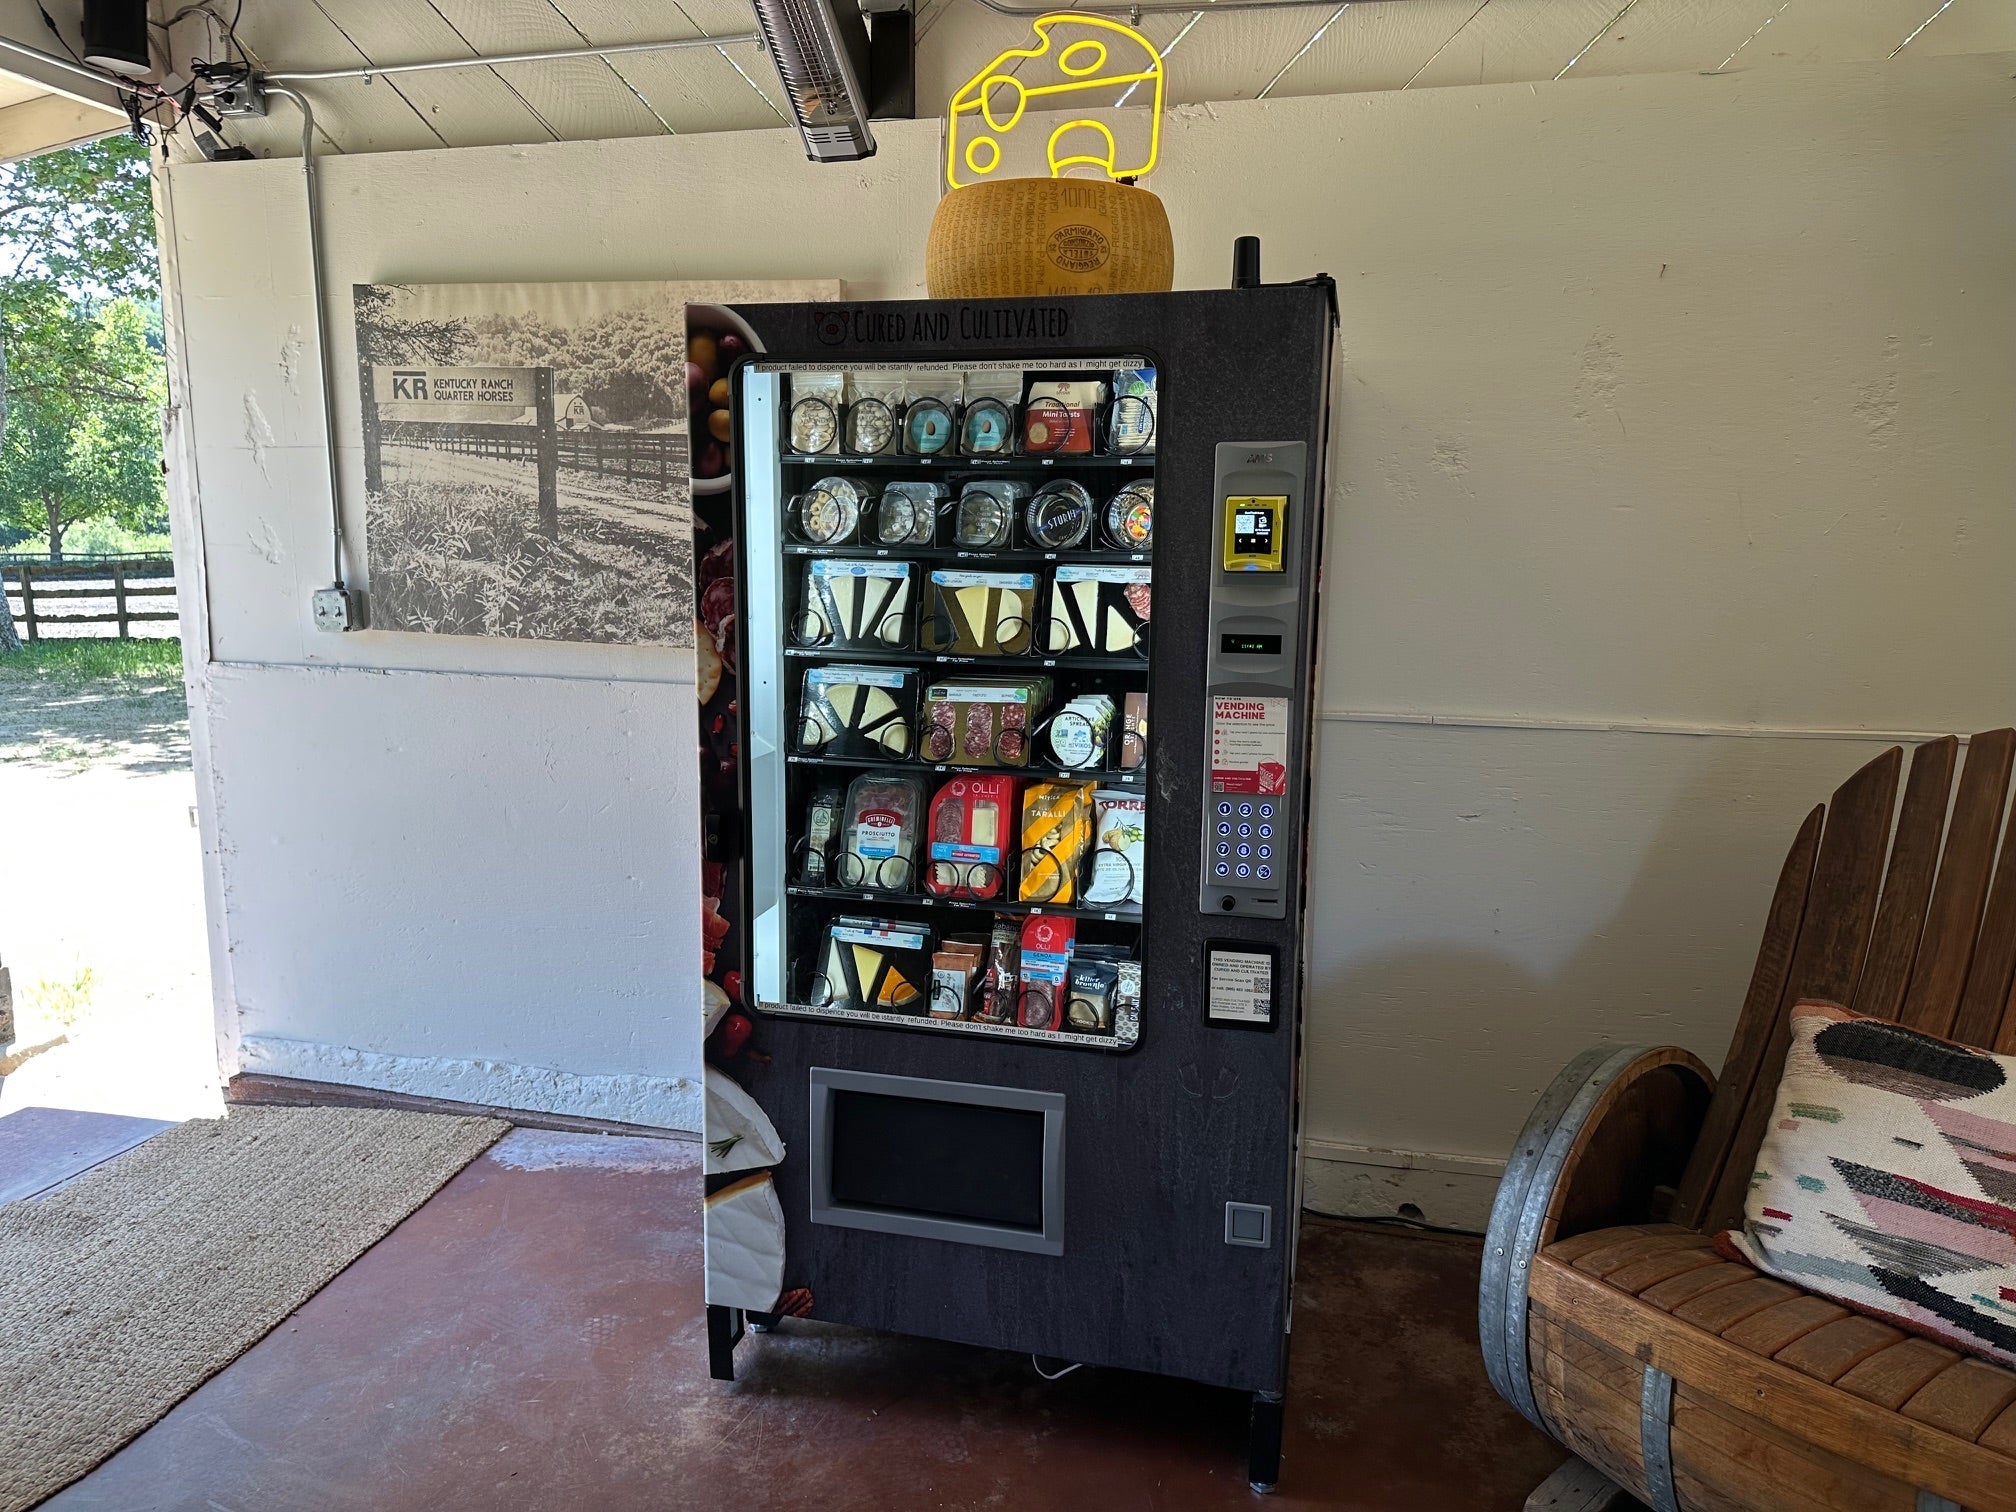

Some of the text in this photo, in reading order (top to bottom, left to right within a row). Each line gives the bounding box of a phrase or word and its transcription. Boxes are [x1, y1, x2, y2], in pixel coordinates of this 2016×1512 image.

[1054, 227, 1104, 246] PARMIGIANO
[1055, 255, 1101, 271] REGGIANO
[762, 364, 787, 372] product
[788, 363, 807, 371] failed
[808, 363, 815, 371] to
[817, 363, 848, 372] dispence
[850, 364, 863, 372] you
[864, 363, 876, 371] will
[877, 363, 887, 371] be
[952, 362, 976, 370] Please
[978, 362, 997, 370] don't
[998, 361, 1020, 369] shake
[1049, 360, 1066, 369] hard
[1086, 360, 1107, 369] might
[1109, 360, 1122, 369] get
[1122, 359, 1143, 369] dizzy
[392, 377, 428, 400] KR
[433, 378, 513, 390] KENTUCKY RANCH
[433, 390, 514, 402] QUARTER HORSES
[1042, 410, 1058, 418] Mini
[1216, 702, 1265, 711] VENDING
[1215, 711, 1265, 720] MACHINE
[1124, 714, 1133, 746] ORNGE
[972, 782, 999, 794] OLLI
[1098, 801, 1145, 811] TORRE
[1031, 810, 1066, 818] TARALLI
[861, 830, 896, 838] PROSCIUTTO
[1035, 943, 1051, 951] OLLI
[1079, 974, 1100, 982] killer
[765, 1003, 788, 1011] product
[790, 1004, 807, 1012] failed
[816, 1006, 845, 1016] dispence
[846, 1010, 858, 1018] you
[860, 1010, 870, 1018] will
[940, 1020, 964, 1028] Please
[965, 1022, 982, 1030] don't
[983, 1024, 1003, 1033] shake
[1029, 1029, 1046, 1038] hard
[1064, 1033, 1084, 1042] might
[1086, 1035, 1098, 1043] get
[1099, 1036, 1117, 1045] dizzy
